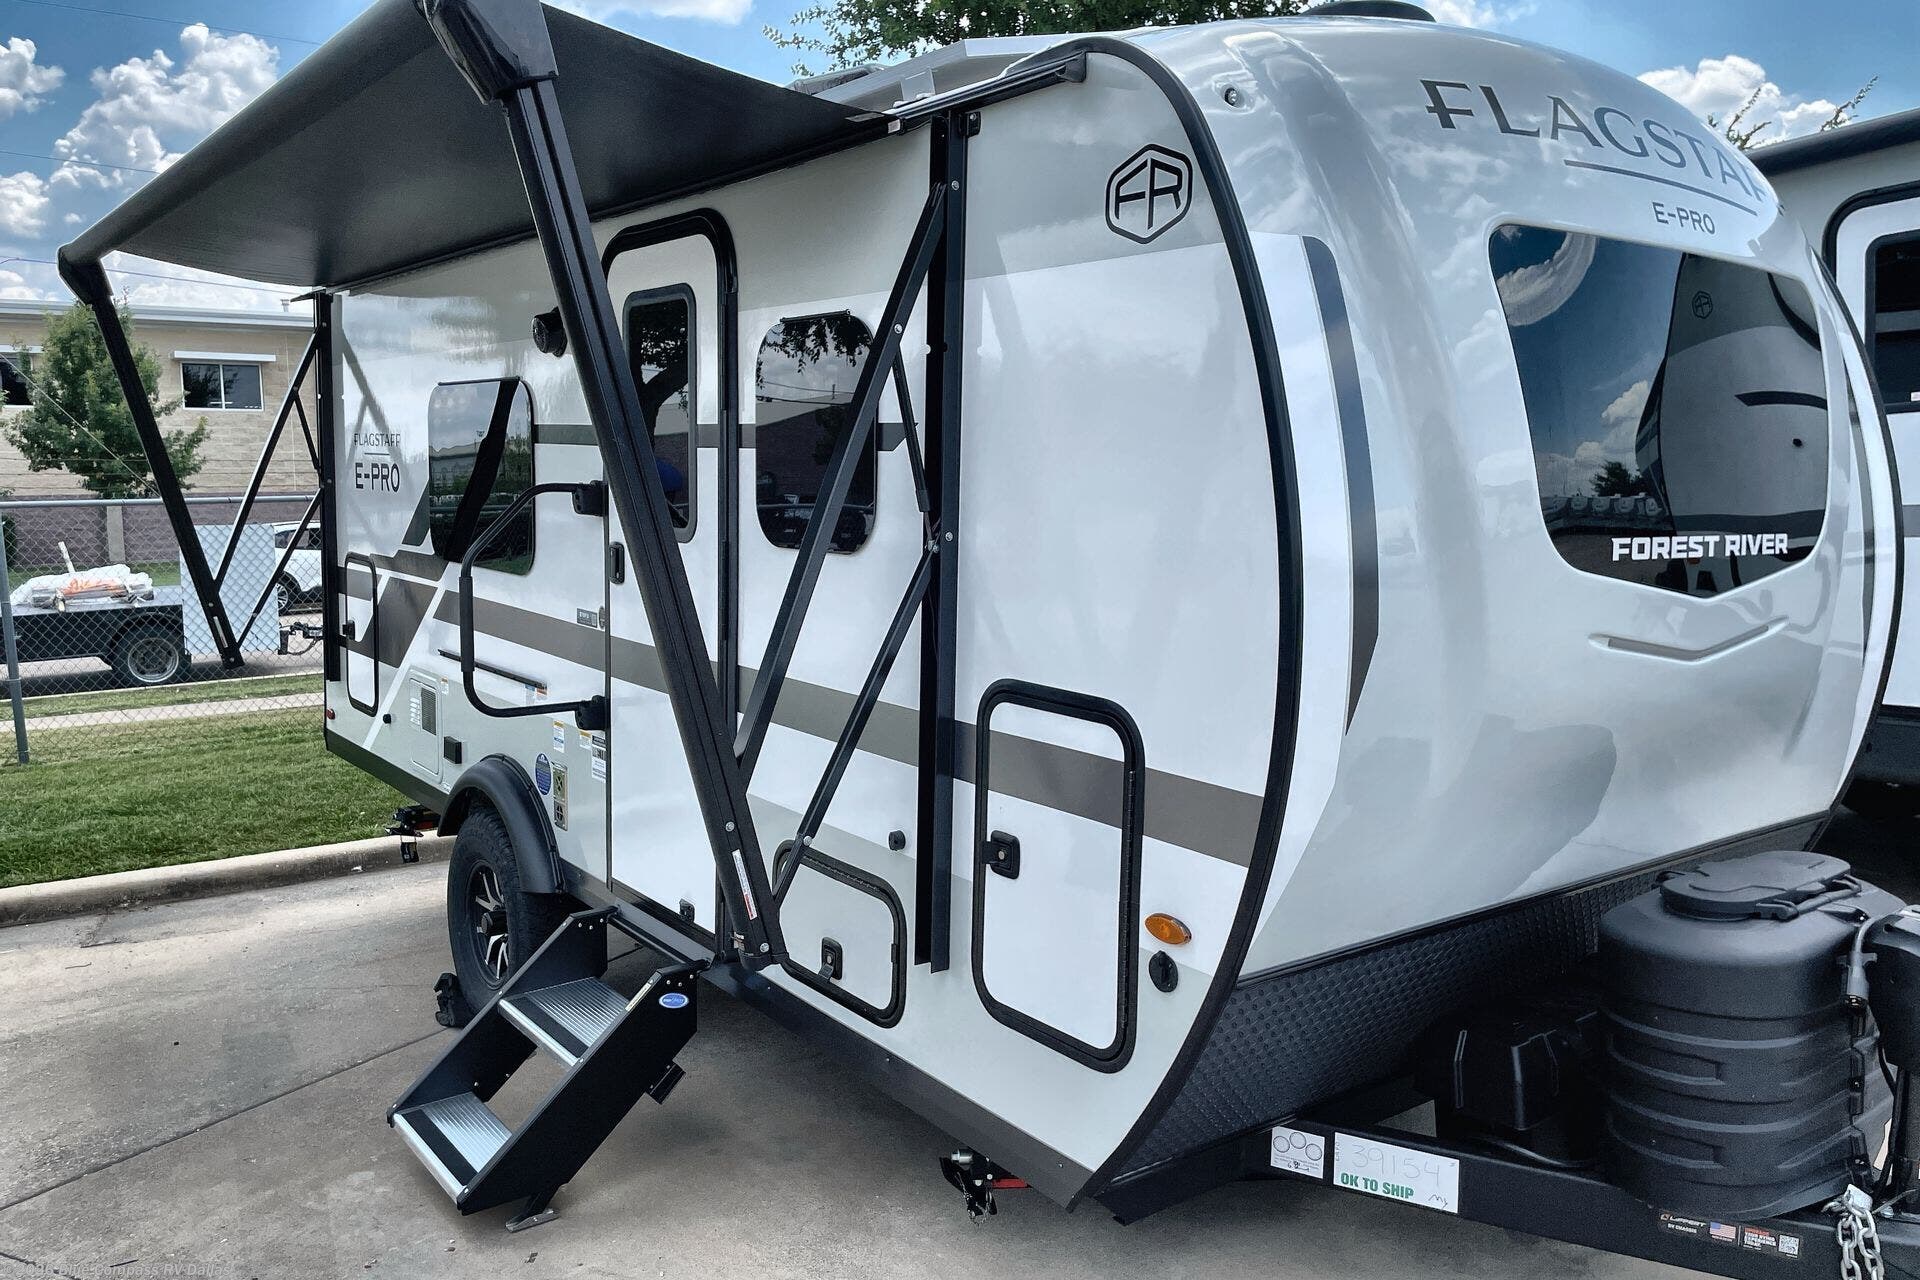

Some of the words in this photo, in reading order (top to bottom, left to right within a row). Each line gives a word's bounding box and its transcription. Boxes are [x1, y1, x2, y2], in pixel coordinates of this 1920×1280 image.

[1419, 79, 1766, 203] FLAGSTAF
[1651, 201, 1715, 235] E-PRO
[353, 433, 400, 447] FLAGSTAFF
[355, 462, 400, 493] E-PRO
[1611, 534, 1720, 561] FOREST
[1724, 533, 1788, 557] RIVER
[1352, 1144, 1440, 1187] 39154
[1340, 1172, 1359, 1187] OK
[1362, 1176, 1379, 1191] TO
[1382, 1182, 1415, 1199] SHIP
